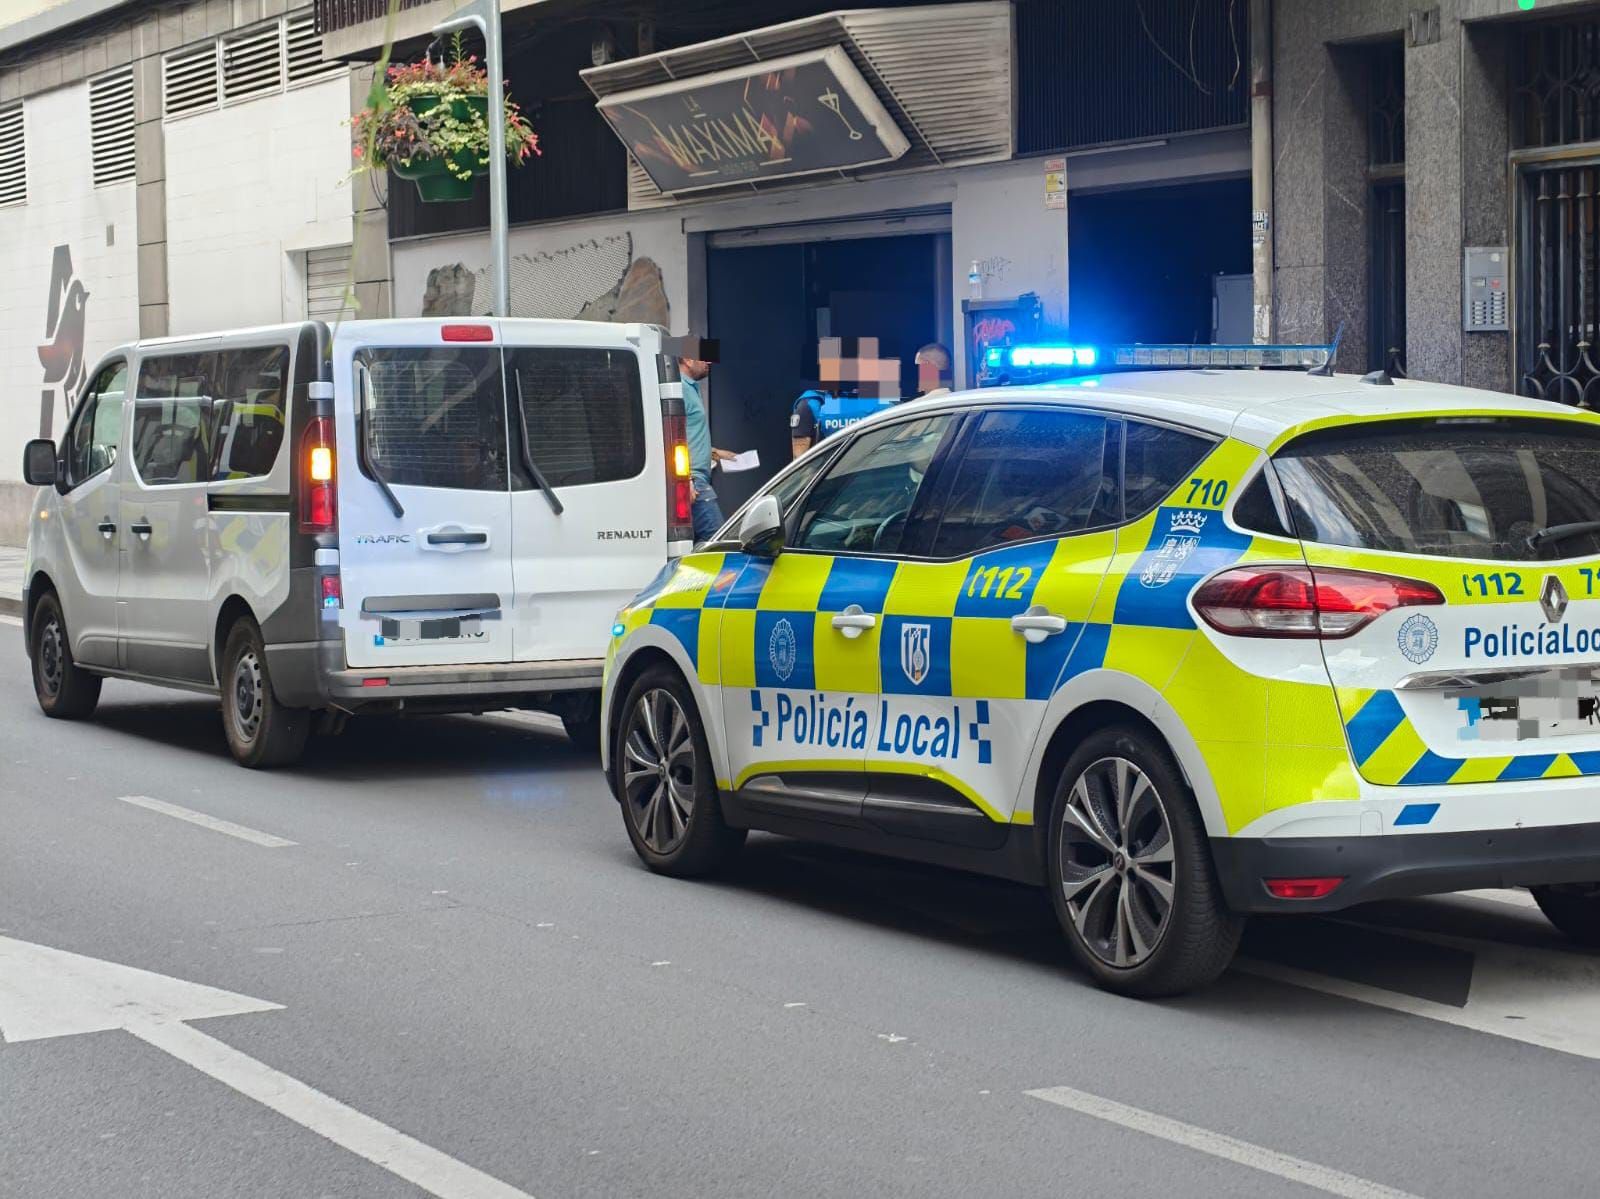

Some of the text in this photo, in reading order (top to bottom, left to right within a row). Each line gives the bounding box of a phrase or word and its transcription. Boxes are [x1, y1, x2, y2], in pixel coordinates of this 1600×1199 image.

[1186, 478, 1229, 506] 710
[357, 535, 411, 544] TRAFIC
[597, 530, 653, 540] RENAULT
[980, 566, 1032, 600] 112
[1472, 572, 1524, 597] 112
[776, 692, 961, 760] Policía Local
